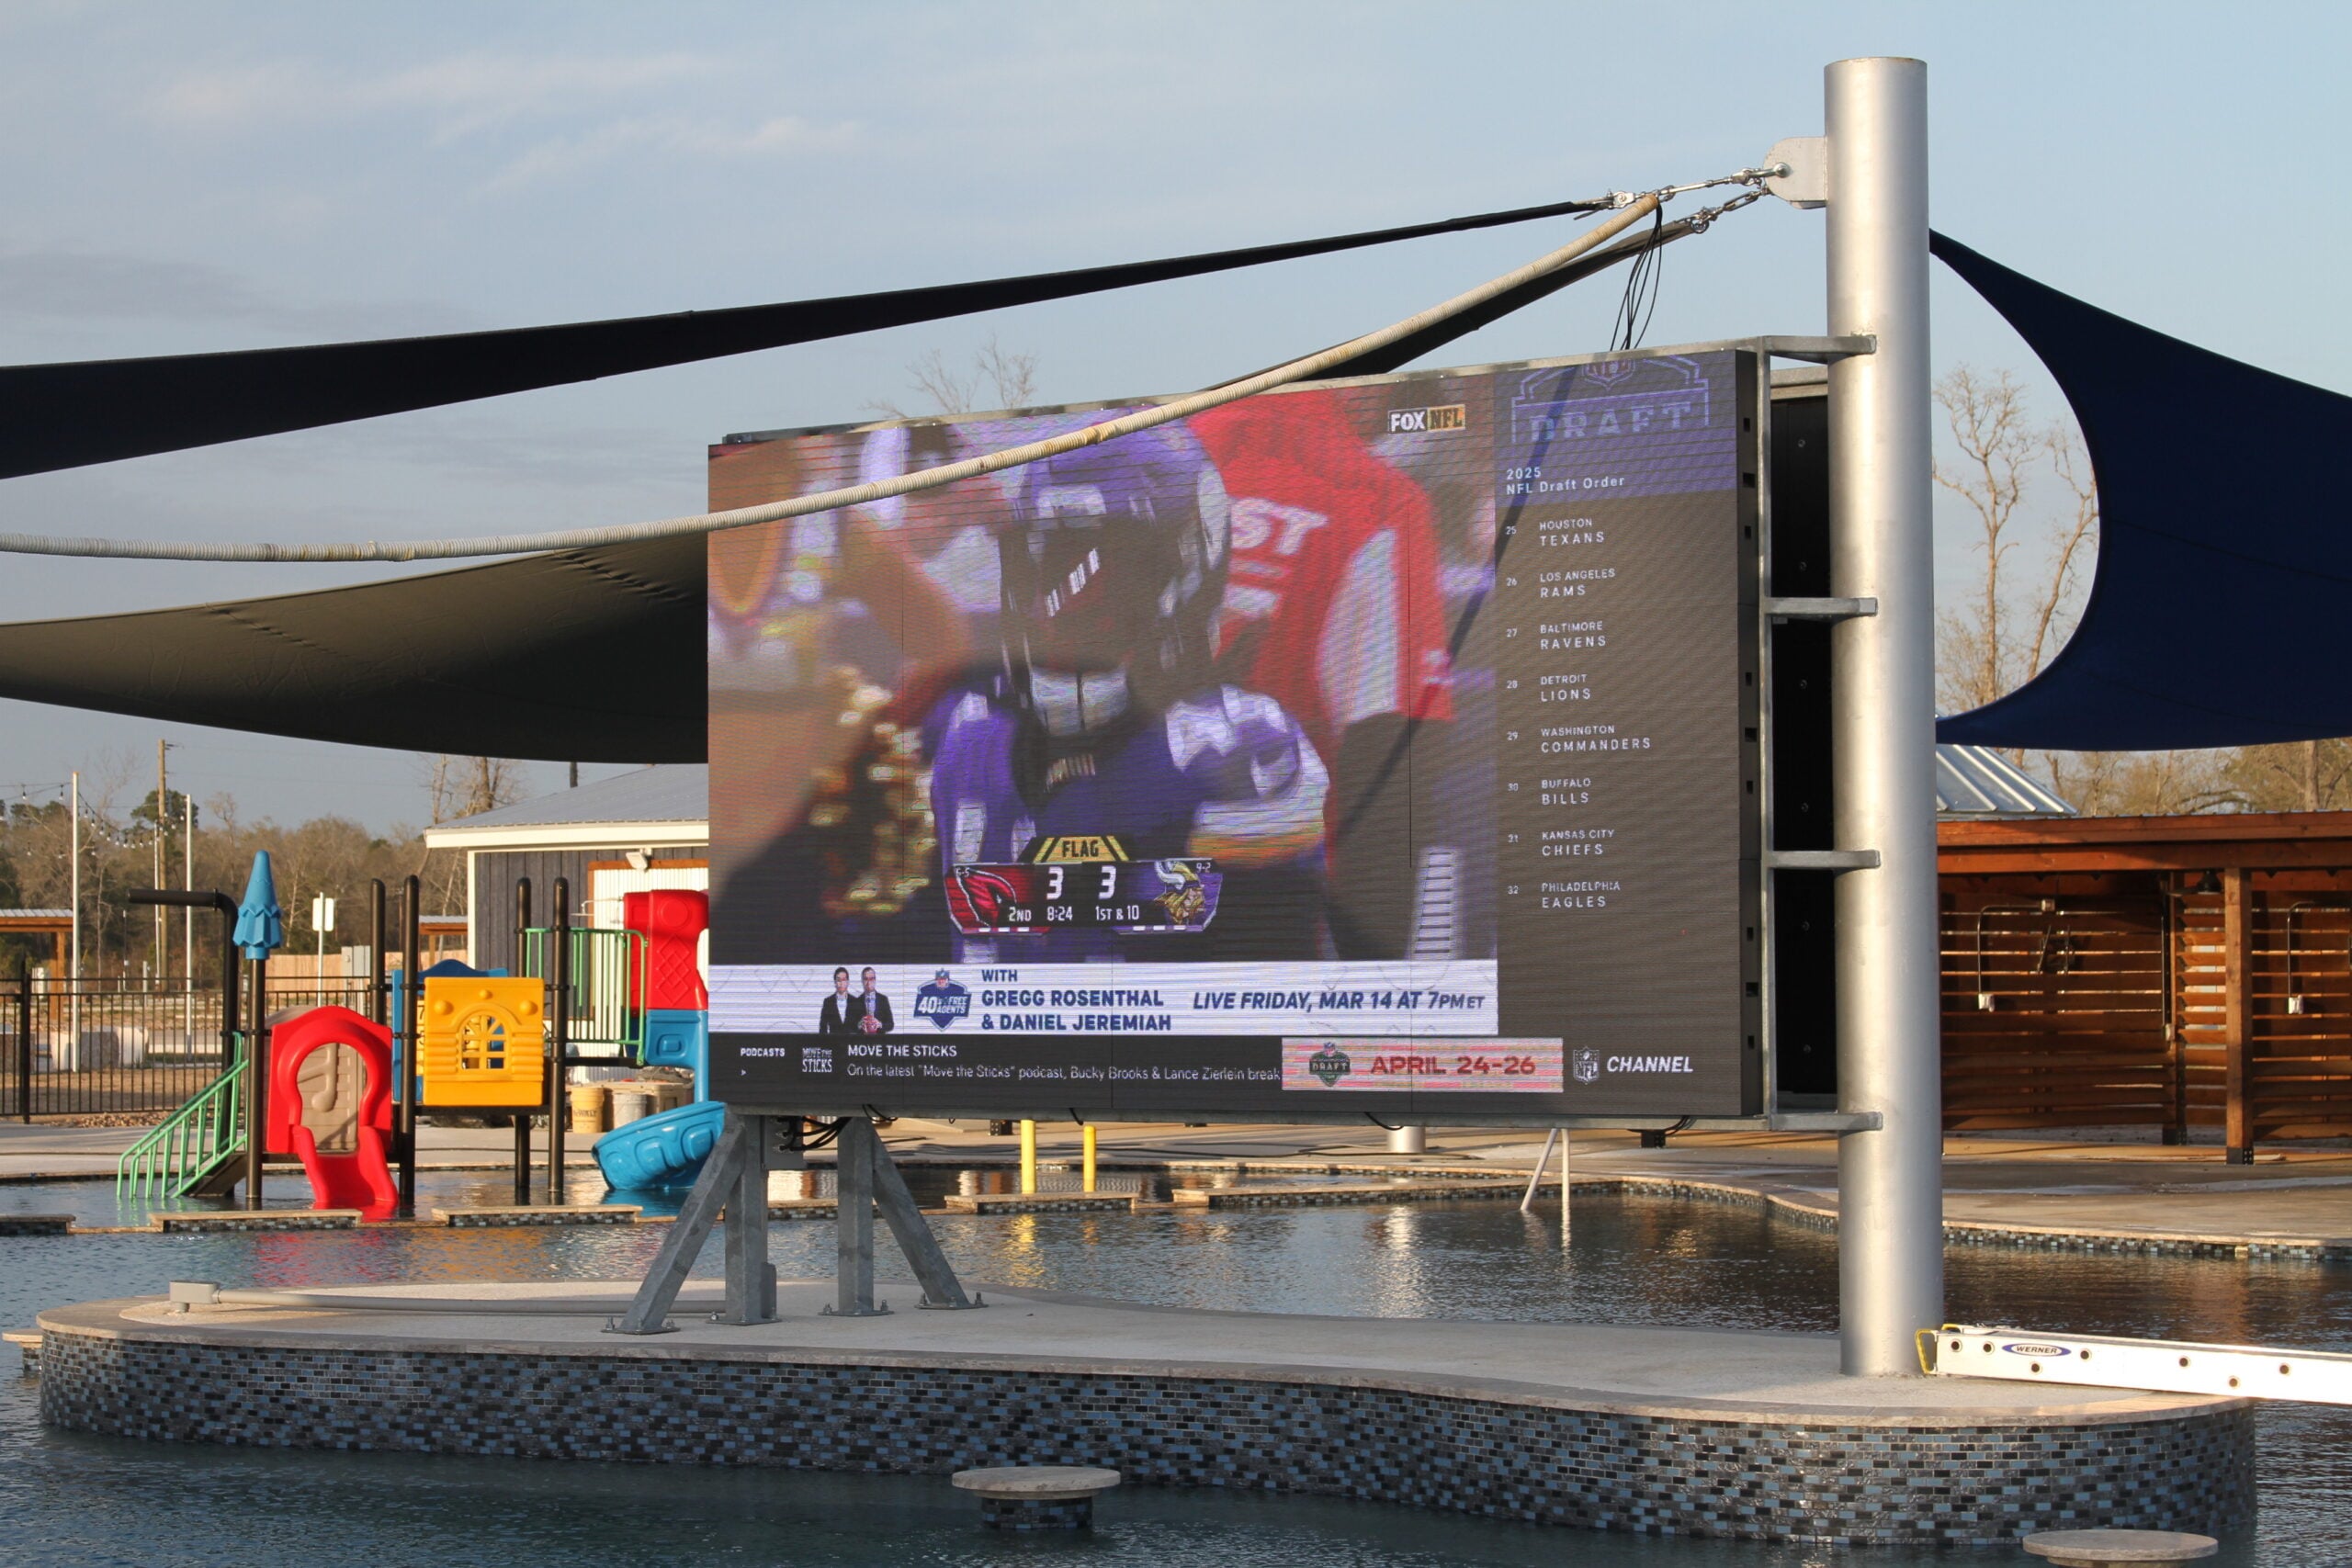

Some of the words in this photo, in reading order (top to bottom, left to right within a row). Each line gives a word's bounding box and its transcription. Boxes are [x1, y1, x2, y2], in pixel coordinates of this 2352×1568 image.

[1390, 411, 1426, 433] FOX
[1430, 408, 1463, 430] NFL
[1530, 401, 1692, 442] DRAFT
[1506, 467, 1542, 480] 2025
[1506, 483, 1532, 495] NFL
[1540, 479, 1577, 492] Draft
[1583, 476, 1625, 490] Order
[1506, 525, 1517, 535] 25
[1539, 518, 1592, 531] HOUSTON
[1540, 531, 1605, 547] TEXANS
[1506, 577, 1518, 587] 26
[1540, 571, 1561, 582] LOS
[1565, 568, 1615, 581] ANGELES
[1540, 584, 1586, 598] RAMS
[1506, 628, 1517, 637] 27
[1540, 620, 1603, 634] BALTIMORE
[1540, 635, 1606, 650] RAVENS
[1540, 673, 1588, 685] DETROIT
[1541, 688, 1591, 702] LIONS
[1541, 725, 1615, 738] WASHINGTON
[1541, 738, 1651, 753] COMMANDERS
[1542, 778, 1591, 789] BUFFALO
[1542, 792, 1589, 805] BILLS
[1542, 830, 1585, 840] KANSAS
[1589, 829, 1615, 839] CITY
[1061, 840, 1099, 858] FLAG
[1542, 843, 1603, 856] CHIEFS
[1046, 866, 1064, 900] 3
[1099, 865, 1116, 900] 3
[1542, 881, 1621, 893] PHILADELPHIA
[1508, 886, 1519, 895] 32
[1542, 896, 1606, 908] EAGLES
[1009, 907, 1032, 922] 2ND
[1046, 906, 1073, 921] 8:24
[1095, 906, 1113, 920] 1ST
[1116, 908, 1124, 920] &
[1126, 905, 1139, 919] 10
[981, 969, 1018, 982] WITH
[981, 989, 1045, 1007] GREGG
[1051, 988, 1164, 1007] ROSENTHAL
[1193, 992, 1236, 1010] LIVE
[1240, 991, 1311, 1012] FRIDAY,
[1319, 991, 1363, 1010] MAR
[1371, 991, 1393, 1009] 14
[1396, 991, 1420, 1009] AT
[981, 1014, 994, 1030] &
[1000, 1014, 1067, 1031] DANIEL
[1073, 1014, 1171, 1031] JEREMIAH
[741, 1047, 786, 1057] PODCASTS
[848, 1044, 883, 1057] MOVE
[886, 1044, 910, 1057] THE
[912, 1044, 957, 1057] STICKS
[802, 1058, 832, 1073] STICKS
[1312, 1062, 1348, 1070] DRAFT
[1371, 1055, 1446, 1075] APRIL
[1456, 1055, 1536, 1075] 24-26
[1607, 1056, 1693, 1073] CHANNEL
[847, 1063, 864, 1076] On
[866, 1064, 883, 1077] the
[885, 1064, 915, 1077] latest
[956, 1066, 974, 1077] the
[1018, 1065, 1068, 1080] podcast,
[1070, 1066, 1103, 1081] Bucky
[1108, 1066, 1148, 1079] Brooks
[1151, 1066, 1161, 1079] &
[1164, 1066, 1199, 1079] Lance
[1248, 1067, 1281, 1080] break
[2016, 1346, 2058, 1354] WERNER
